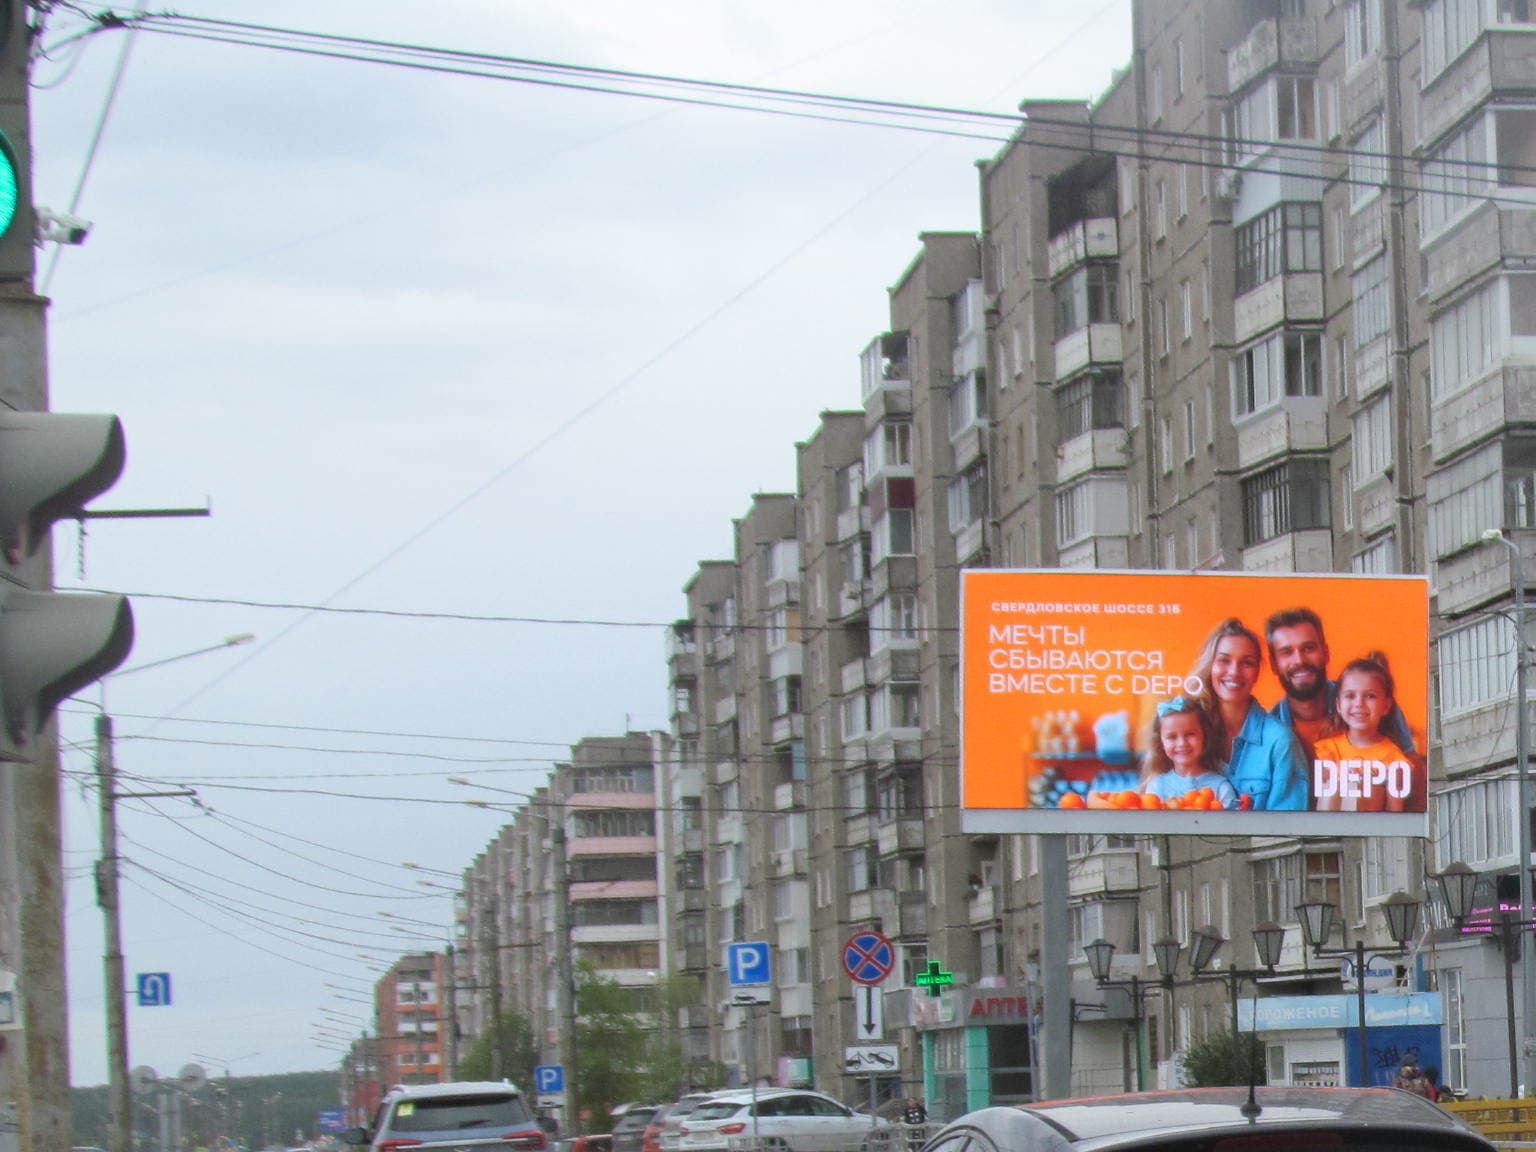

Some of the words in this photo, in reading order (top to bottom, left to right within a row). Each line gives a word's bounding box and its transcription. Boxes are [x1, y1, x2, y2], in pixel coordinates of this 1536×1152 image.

[991, 602, 1100, 614] СВЕРДЛОВСКОЕ
[1103, 603, 1154, 614] ШОССЕ
[989, 624, 1086, 645] МЕЧТЫ
[989, 649, 1163, 670] СБЫВАЮТСЯ
[989, 673, 1098, 694] ВМЕСТЕ
[1105, 674, 1124, 695] С
[1132, 675, 1204, 695] DEPO
[1314, 759, 1411, 798] DEPO
[737, 947, 761, 980] P
[969, 996, 1043, 1017] АПТЕ
